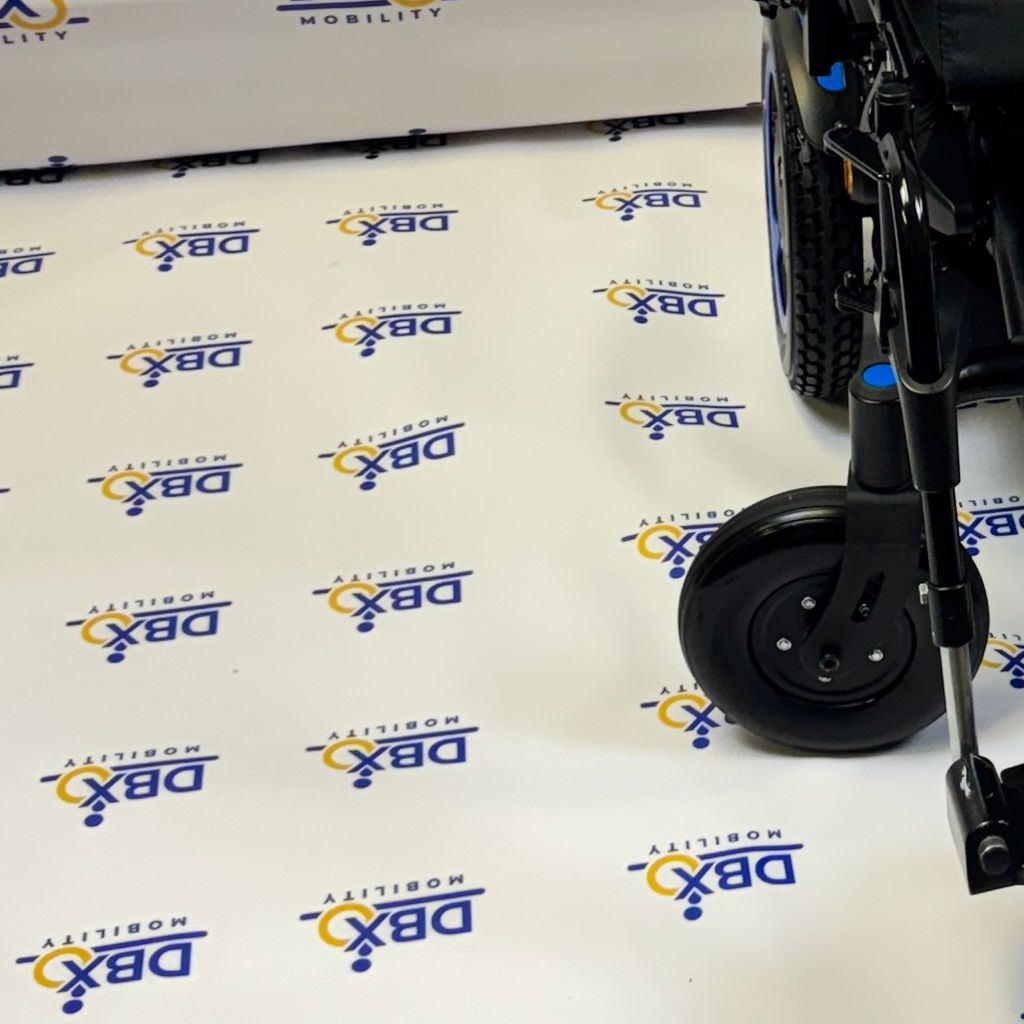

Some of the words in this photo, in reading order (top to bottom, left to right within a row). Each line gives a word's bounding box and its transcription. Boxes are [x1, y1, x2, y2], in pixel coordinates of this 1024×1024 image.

[300, 8, 441, 25] MOBILITY
[4, 31, 67, 44] LITY
[598, 182, 692, 194] MOBILITY
[614, 193, 701, 207] DBX
[344, 204, 443, 215] MOBILITY
[143, 221, 245, 235] MOBILITY
[359, 215, 448, 235] DBX
[155, 235, 249, 260] DBX
[610, 279, 709, 290] MOBILITY
[340, 304, 445, 319] MOBILITY
[626, 293, 718, 317] DBX
[356, 316, 451, 340] DBX
[127, 332, 236, 350] MOBILITY
[140, 347, 240, 376] DBX
[622, 393, 728, 402] MOBILITY
[640, 409, 739, 428] DBX
[338, 416, 447, 449] MOBILITY
[109, 455, 226, 472] MOBILITY
[355, 432, 455, 478] DBX
[123, 471, 230, 503] DBX
[639, 509, 735, 527] OBILITY
[334, 562, 454, 583] MOBILITY
[89, 591, 214, 614] MOBILITY
[351, 579, 461, 617] DBX
[103, 610, 218, 649] DBX
[329, 716, 459, 740] MOBILITY
[64, 745, 200, 767] MOBILITY
[347, 736, 466, 777] DBX
[80, 764, 204, 807] DBX
[649, 830, 781, 855] MOBILITY
[672, 854, 796, 898] DBX
[324, 874, 463, 904] MOBILITY
[42, 917, 187, 948] MOBILITY
[344, 900, 472, 952] DBX
[58, 942, 192, 995] DBX
